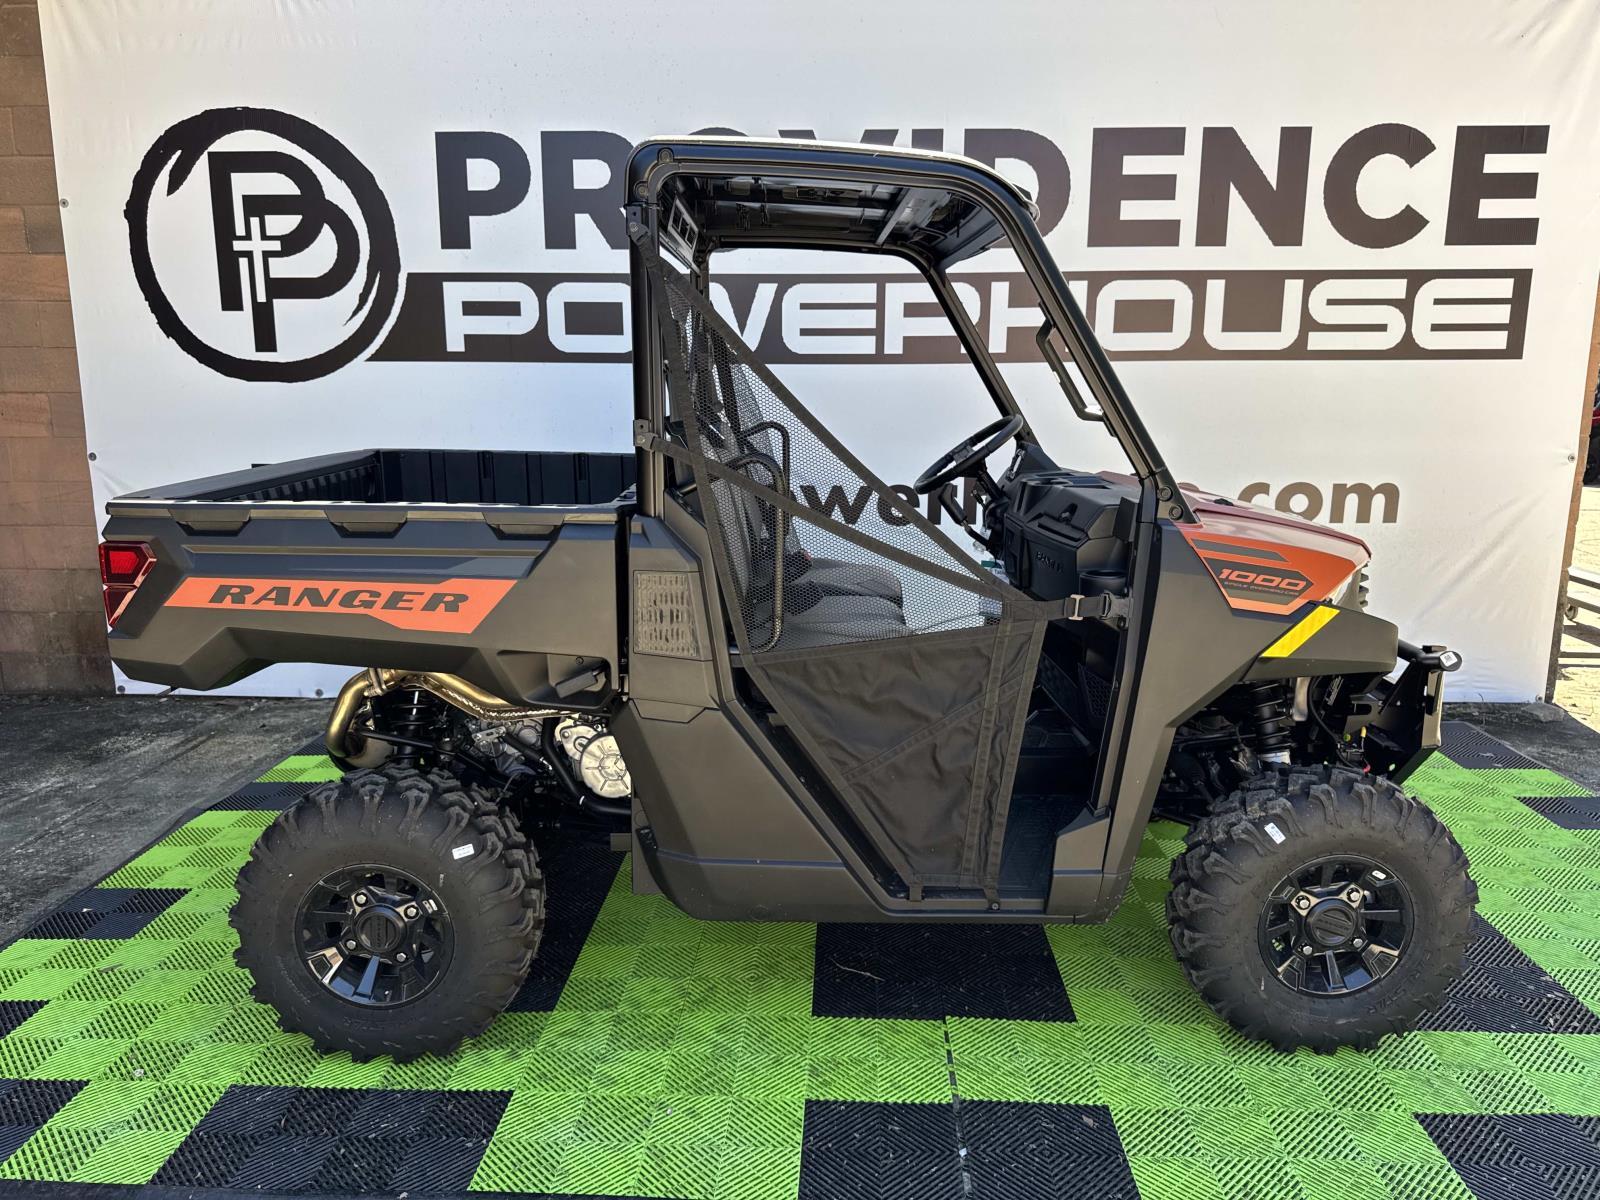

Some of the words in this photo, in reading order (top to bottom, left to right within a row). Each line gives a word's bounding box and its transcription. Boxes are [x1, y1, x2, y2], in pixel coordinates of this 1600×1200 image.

[434, 123, 1549, 250] PRDENCE
[1219, 568, 1307, 591] 1000
[208, 584, 469, 613] RANGER
